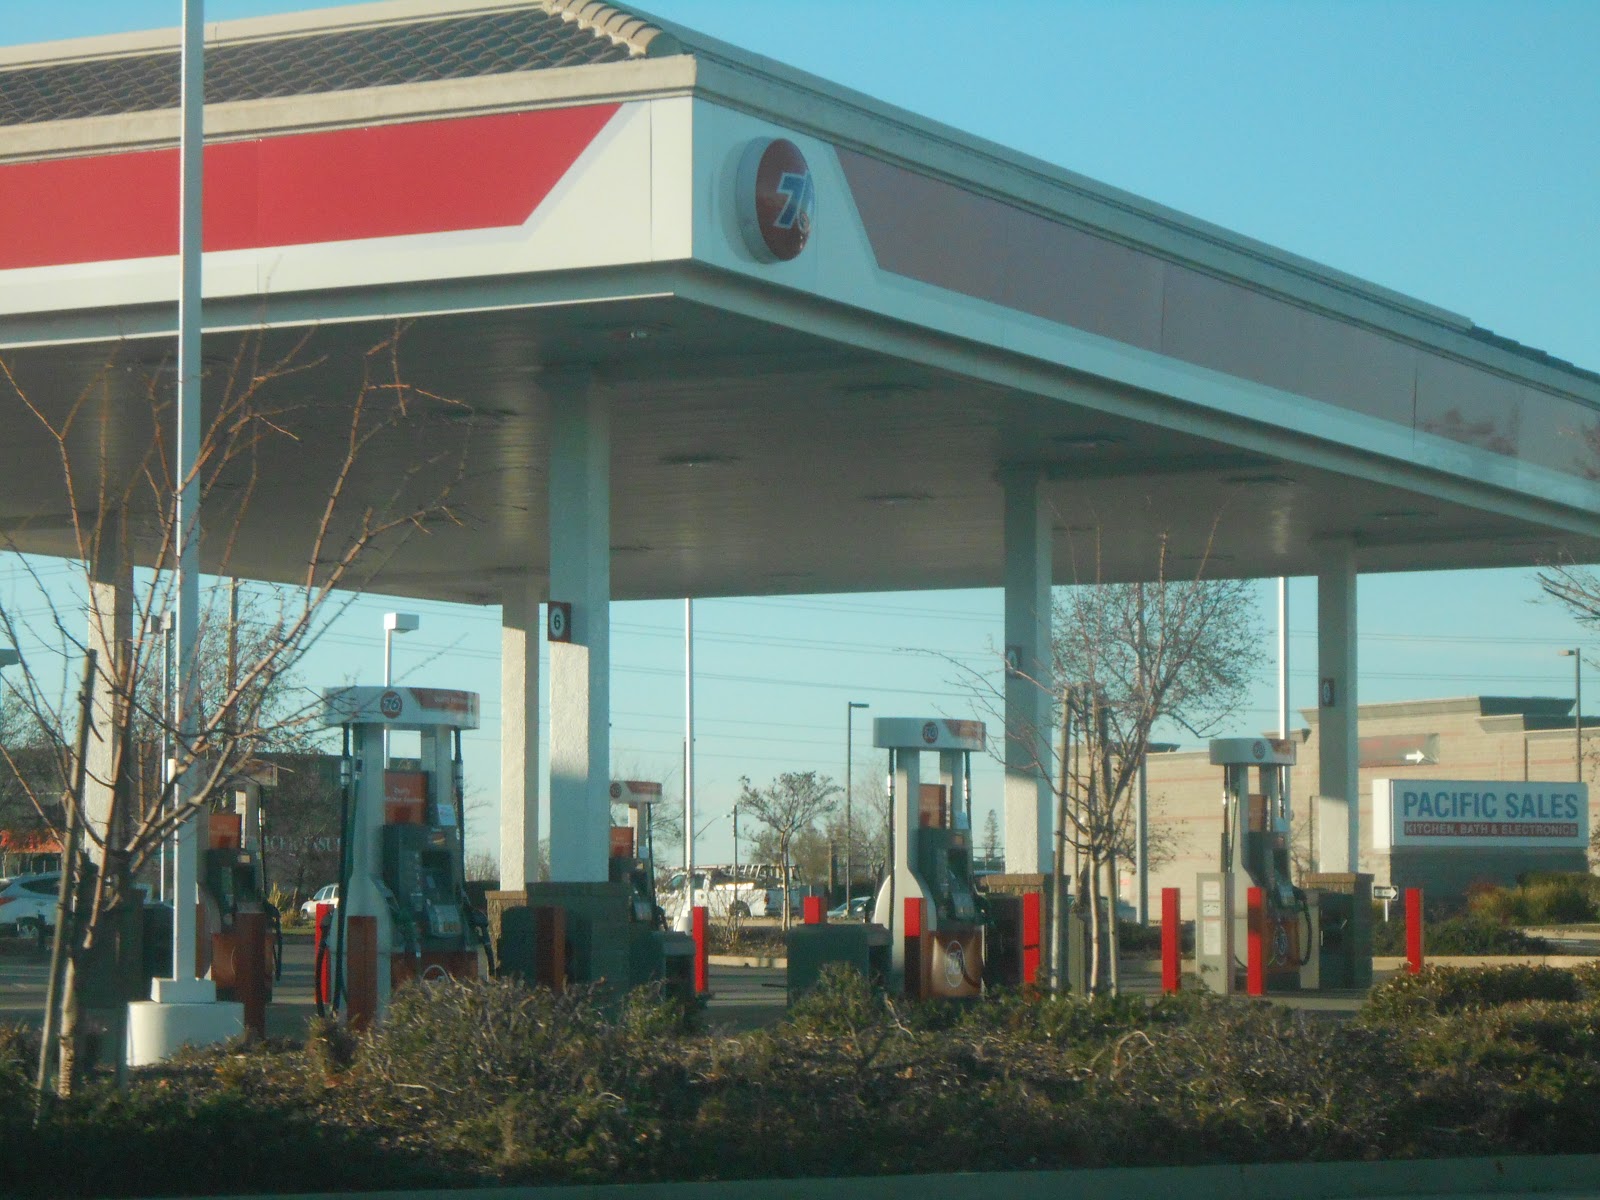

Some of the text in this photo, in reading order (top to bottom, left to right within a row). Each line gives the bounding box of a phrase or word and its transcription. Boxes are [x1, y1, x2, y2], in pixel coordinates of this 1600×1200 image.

[553, 614, 562, 631] 6
[383, 695, 401, 712] 76
[1403, 791, 1578, 819] PACIFIC SALES
[1405, 823, 1577, 836] KITCHEN, BATH & ELECTRONICS
